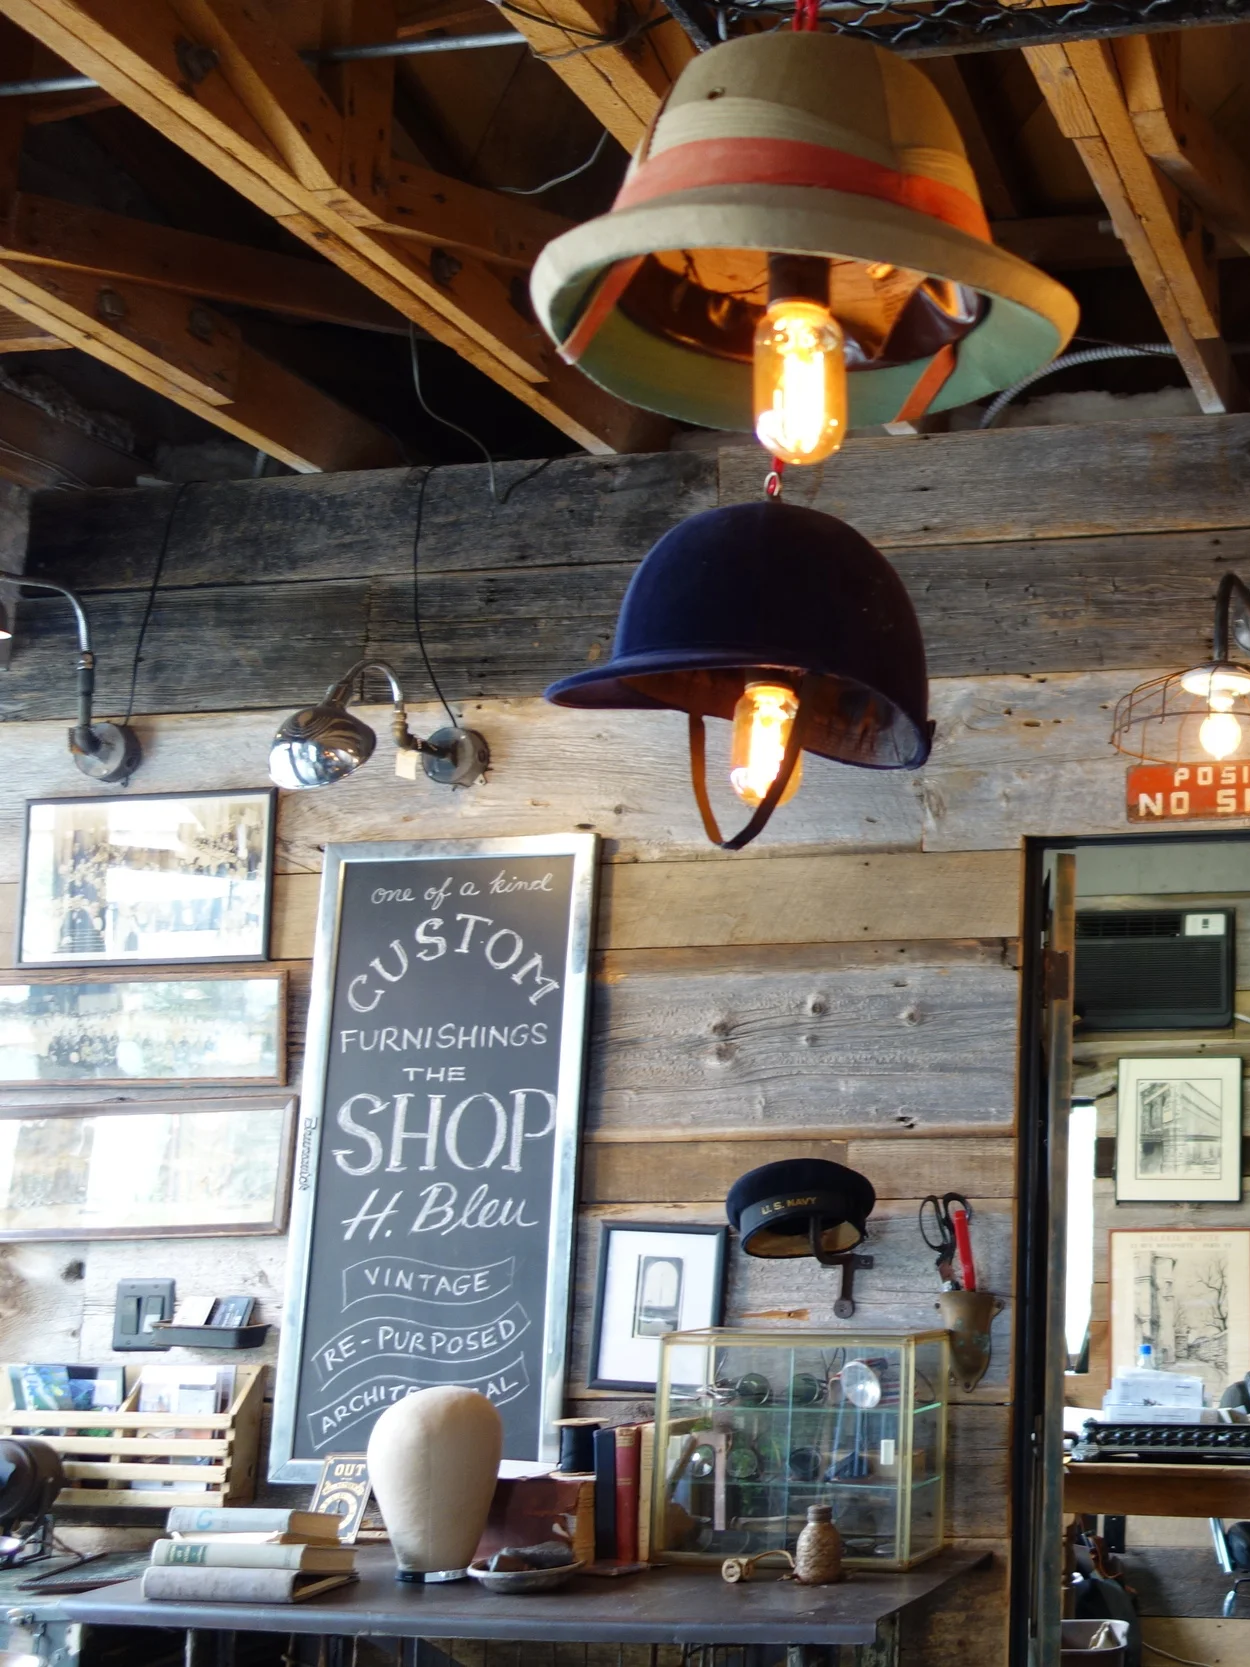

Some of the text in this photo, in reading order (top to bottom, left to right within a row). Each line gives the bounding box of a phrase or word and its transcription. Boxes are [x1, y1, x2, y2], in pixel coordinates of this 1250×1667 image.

[1138, 790, 1190, 816] NO
[371, 870, 554, 910] one of a kind
[347, 913, 560, 1014] CUSTOM
[340, 1022, 549, 1053] FURNISHINGS
[403, 1066, 467, 1082] THE
[331, 1088, 557, 1176] SHOP
[341, 1182, 540, 1241] H. Bleu
[786, 1197, 817, 1208] NAVY
[364, 1266, 491, 1296] VINTAGE
[323, 1319, 517, 1371] RE-PURPOSED
[334, 1463, 367, 1477] OUT
